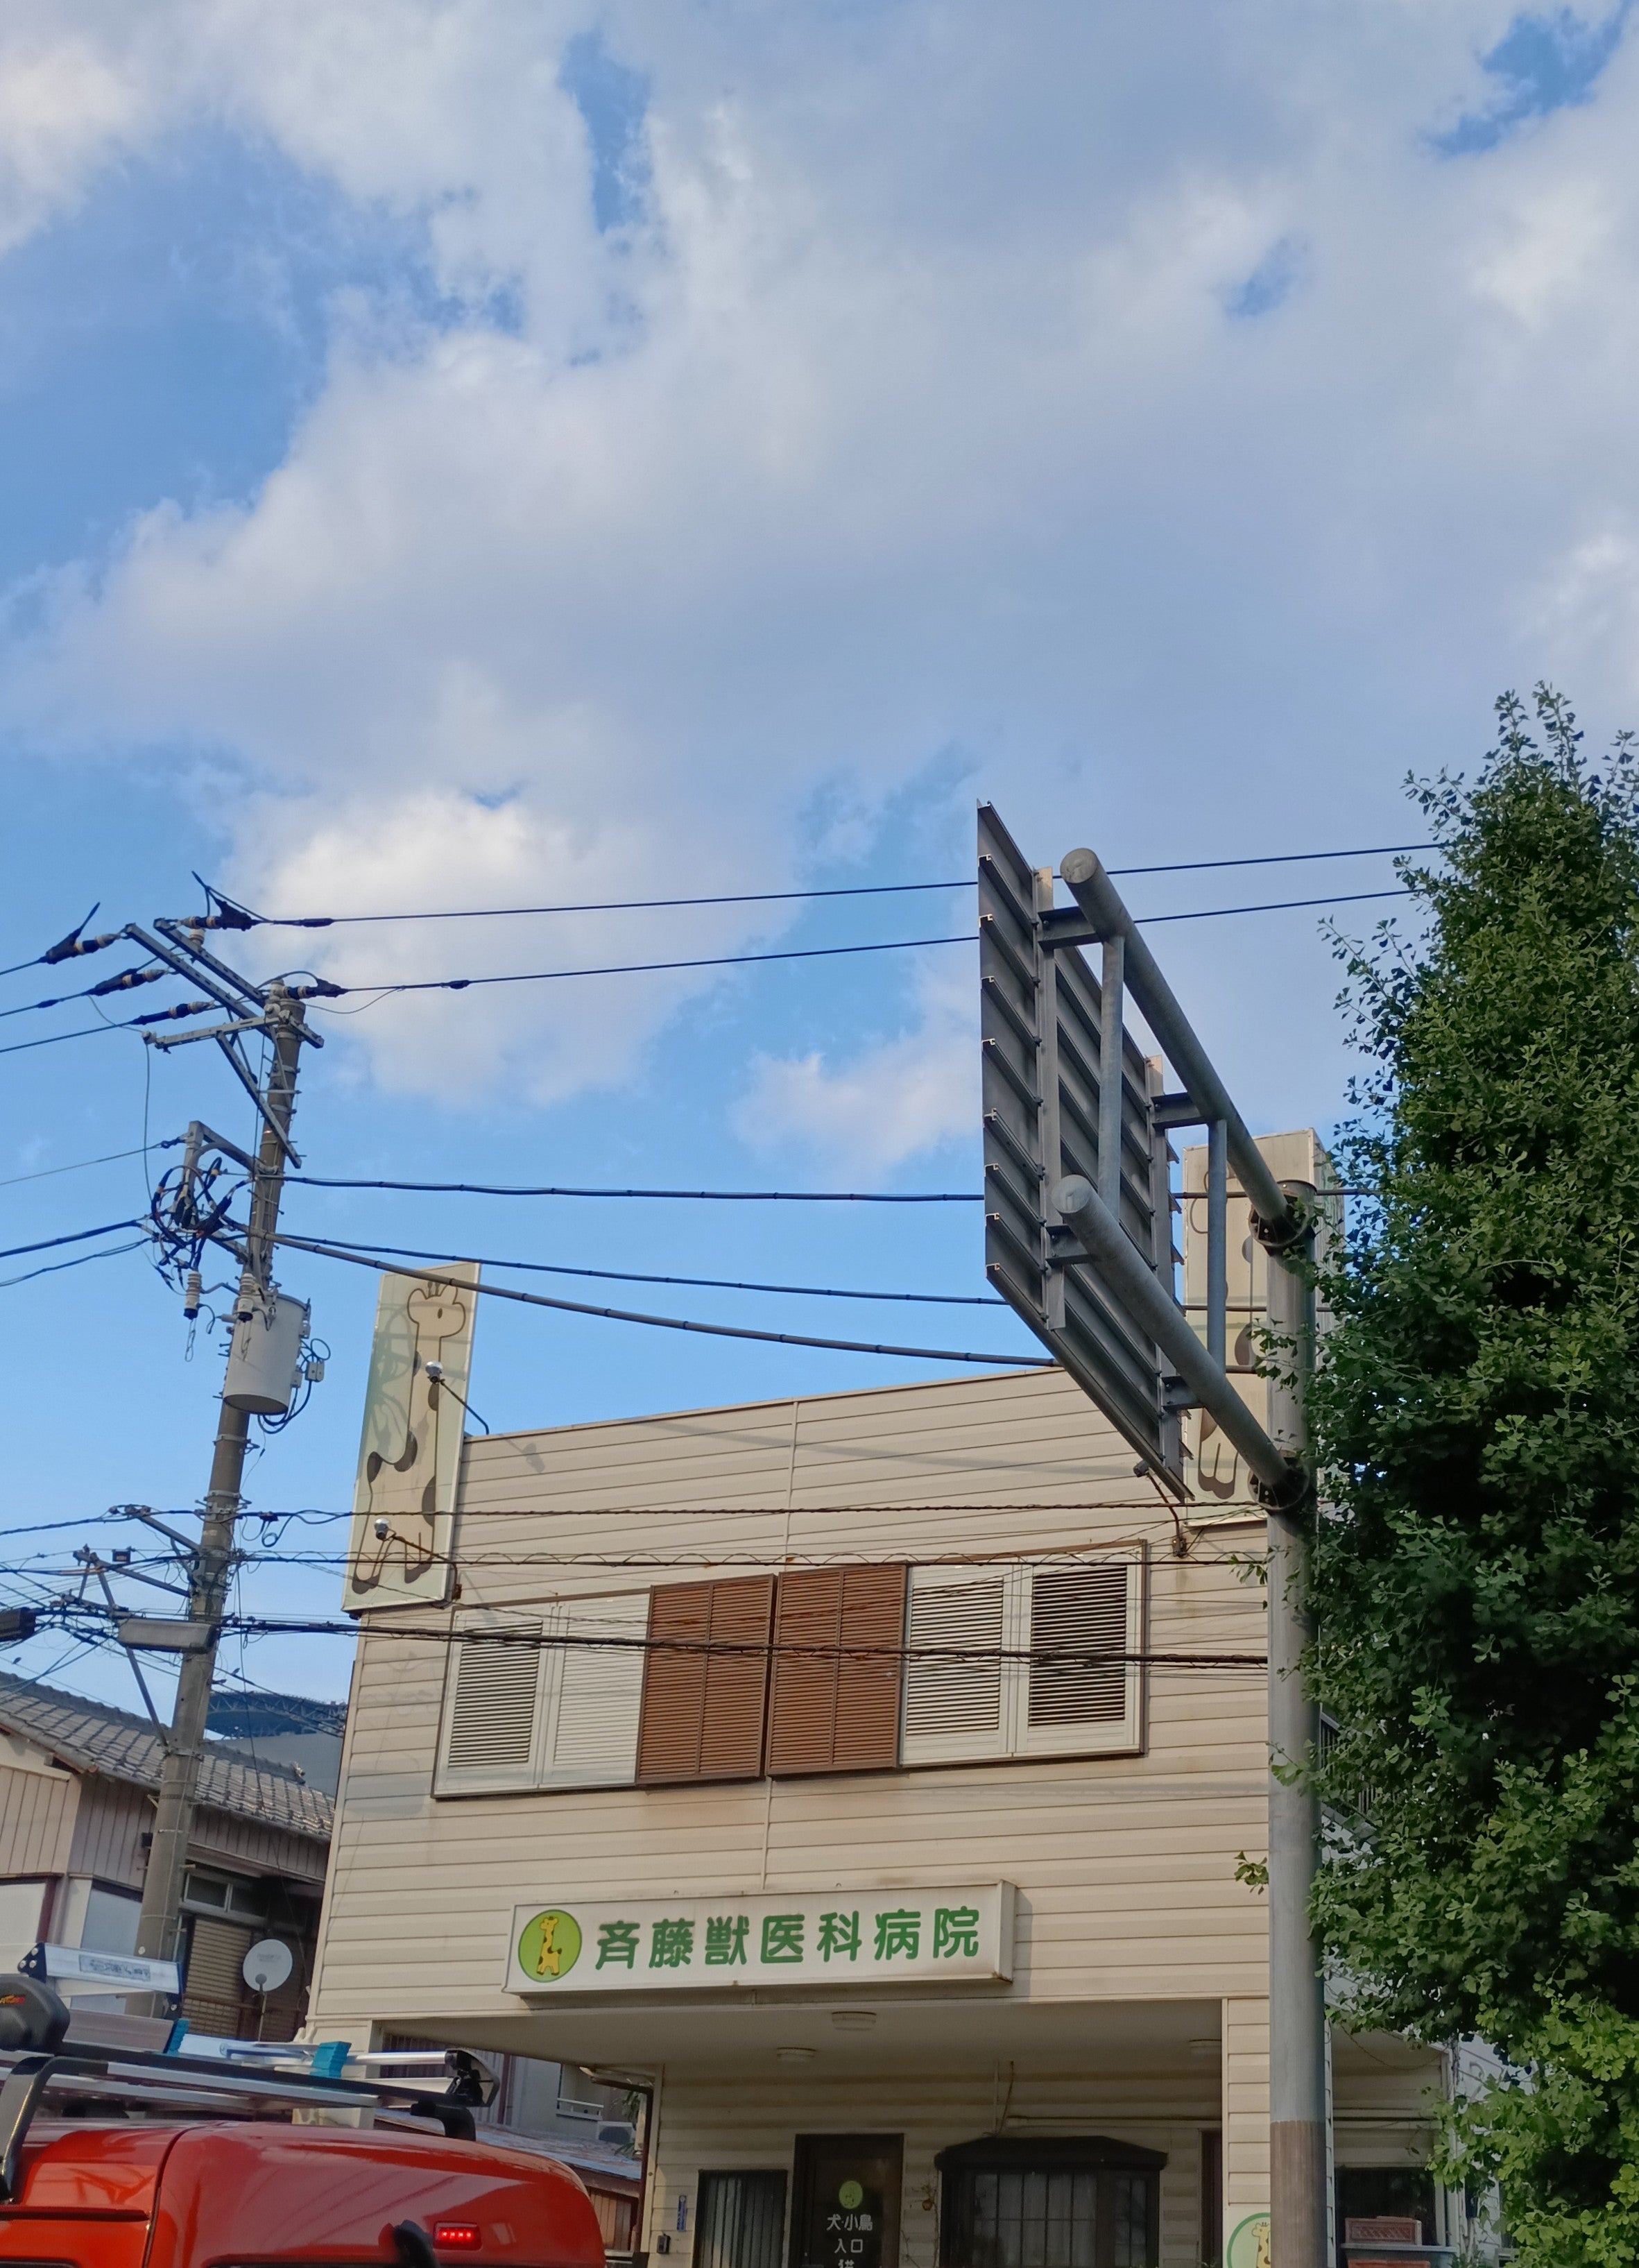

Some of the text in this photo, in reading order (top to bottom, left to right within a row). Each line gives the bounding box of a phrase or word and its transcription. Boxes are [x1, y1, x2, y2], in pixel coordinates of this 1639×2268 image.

[595, 1906, 979, 1970] 斉藤獣医科病院
[834, 2238, 863, 2253] 入口
